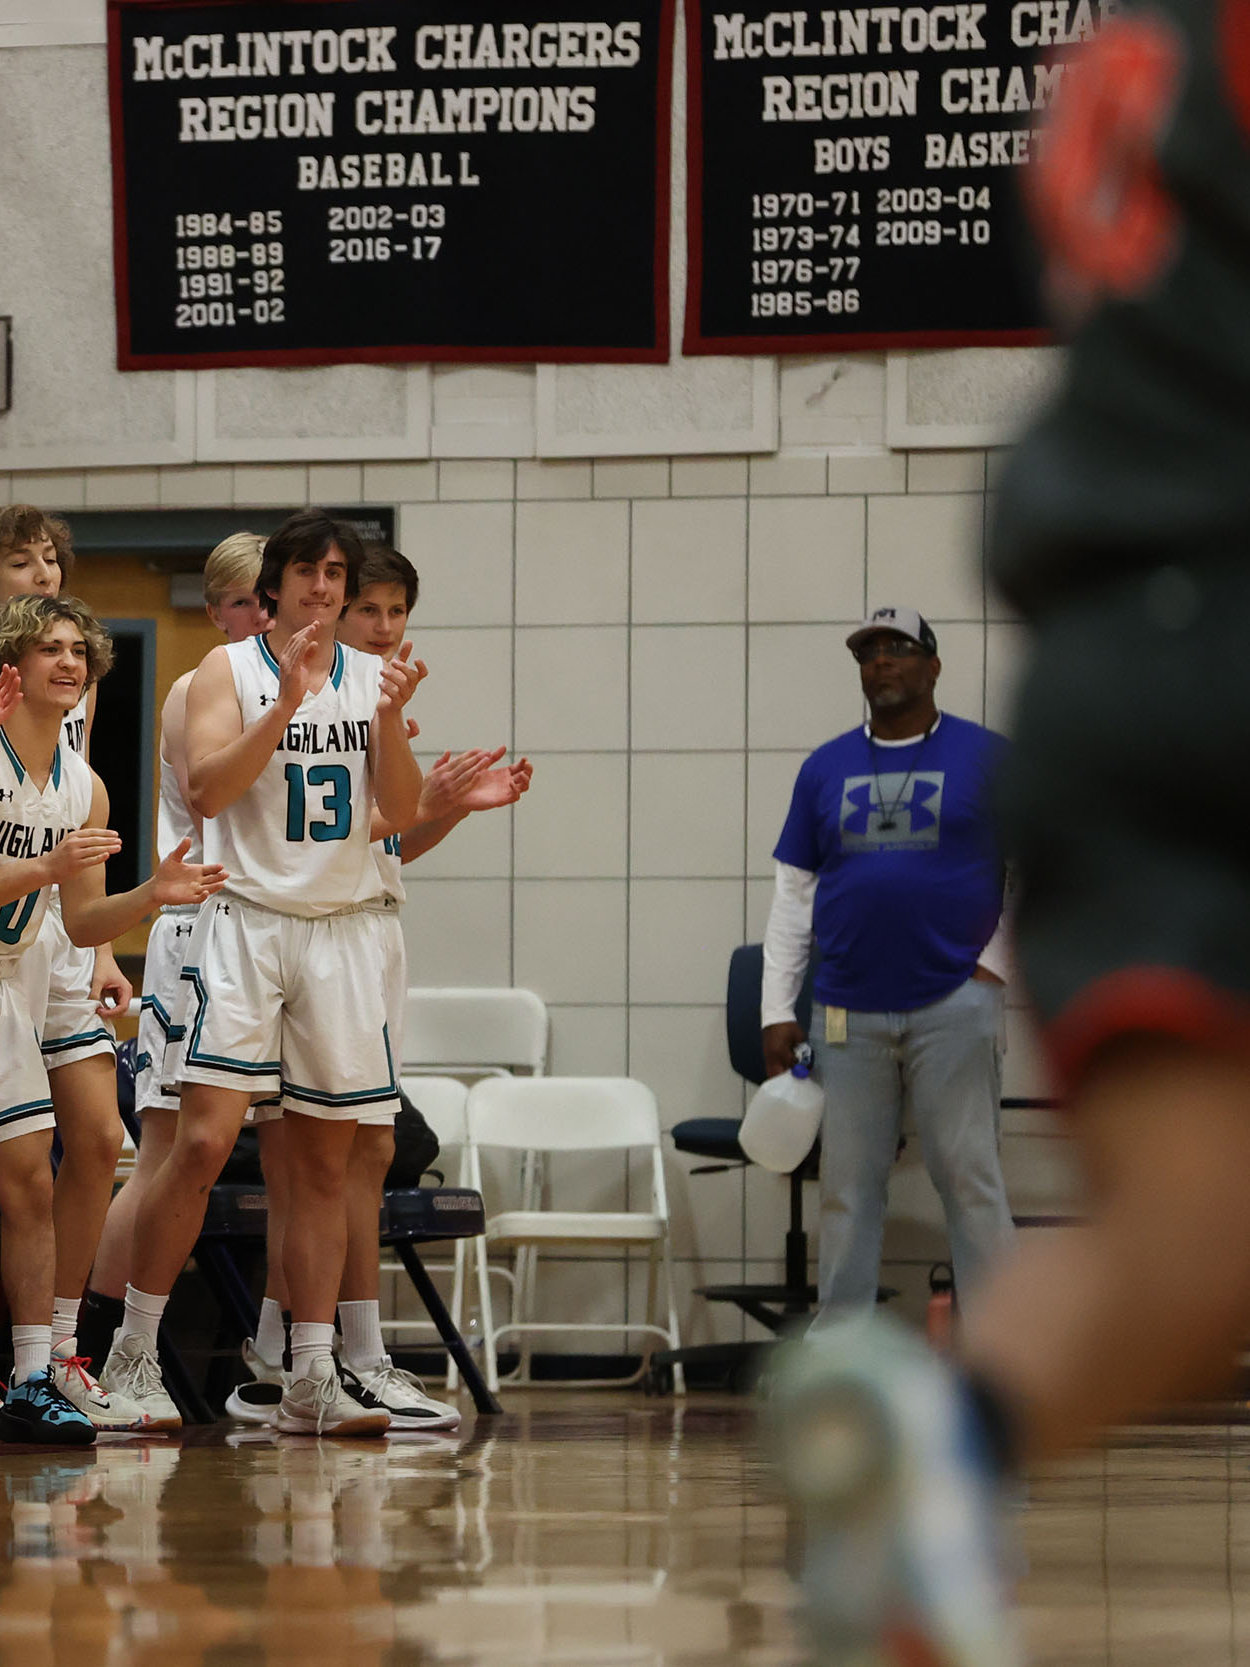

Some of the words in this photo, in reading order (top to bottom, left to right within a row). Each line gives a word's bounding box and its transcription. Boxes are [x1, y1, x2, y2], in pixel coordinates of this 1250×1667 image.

[713, 4, 987, 61] McCLINTOCK
[133, 27, 397, 82] McCLINTOCK
[415, 22, 641, 70] CHARGERS
[762, 70, 920, 122] REGION
[179, 92, 335, 142] REGION
[356, 86, 597, 136] CHAMPIONS
[814, 136, 891, 175] BOYS
[297, 152, 480, 190] BASEBALL
[752, 190, 860, 218] 1970-71
[876, 185, 991, 214] 2003-04
[176, 210, 283, 237] 1984-85
[328, 204, 445, 231] 2002-03
[752, 223, 860, 252] 1973-74
[876, 219, 991, 246] 2009-10
[176, 242, 284, 270] 1988-89
[329, 236, 442, 263] 2016-17
[180, 268, 285, 299] 1991-92
[751, 256, 860, 284] 1976-77
[176, 298, 286, 328] 2001-02
[751, 288, 860, 317] 1985-86
[285, 763, 352, 842] 13
